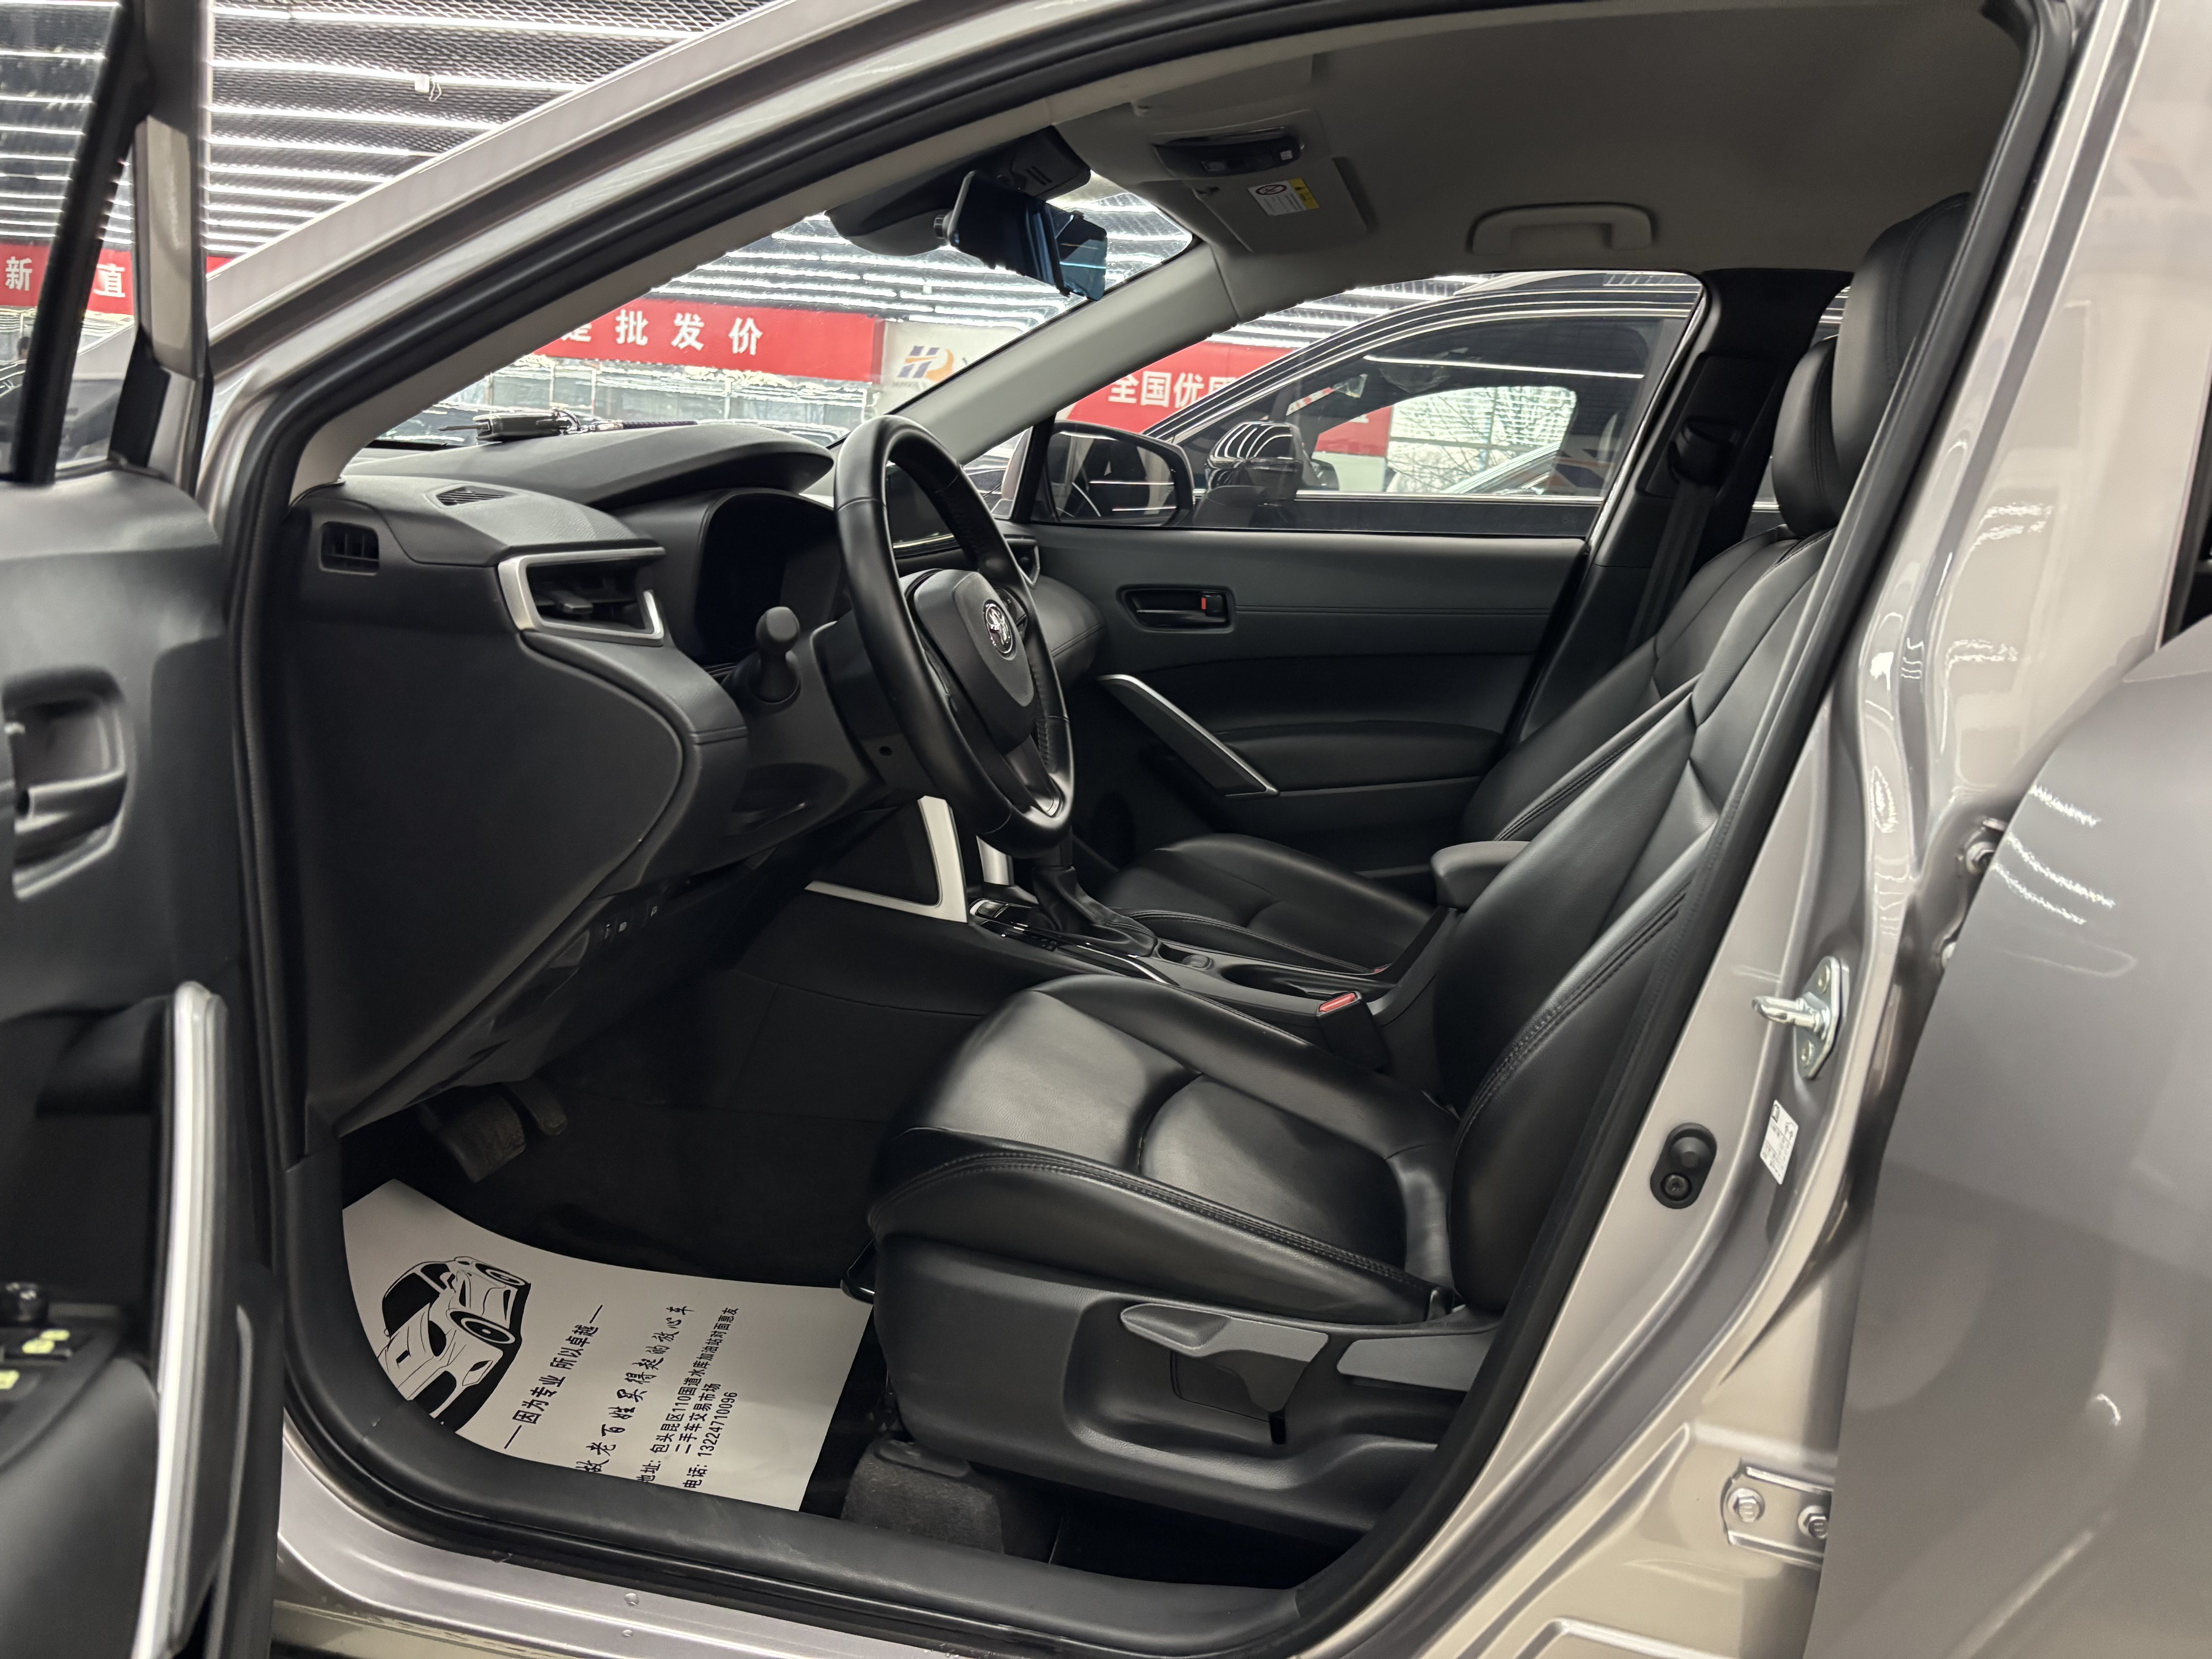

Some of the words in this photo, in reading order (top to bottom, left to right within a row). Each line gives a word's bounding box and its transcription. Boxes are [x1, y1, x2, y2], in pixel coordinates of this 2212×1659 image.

[675, 1383, 721, 1454] 二手车交易市场
[697, 1392, 738, 1457] 13224710096
